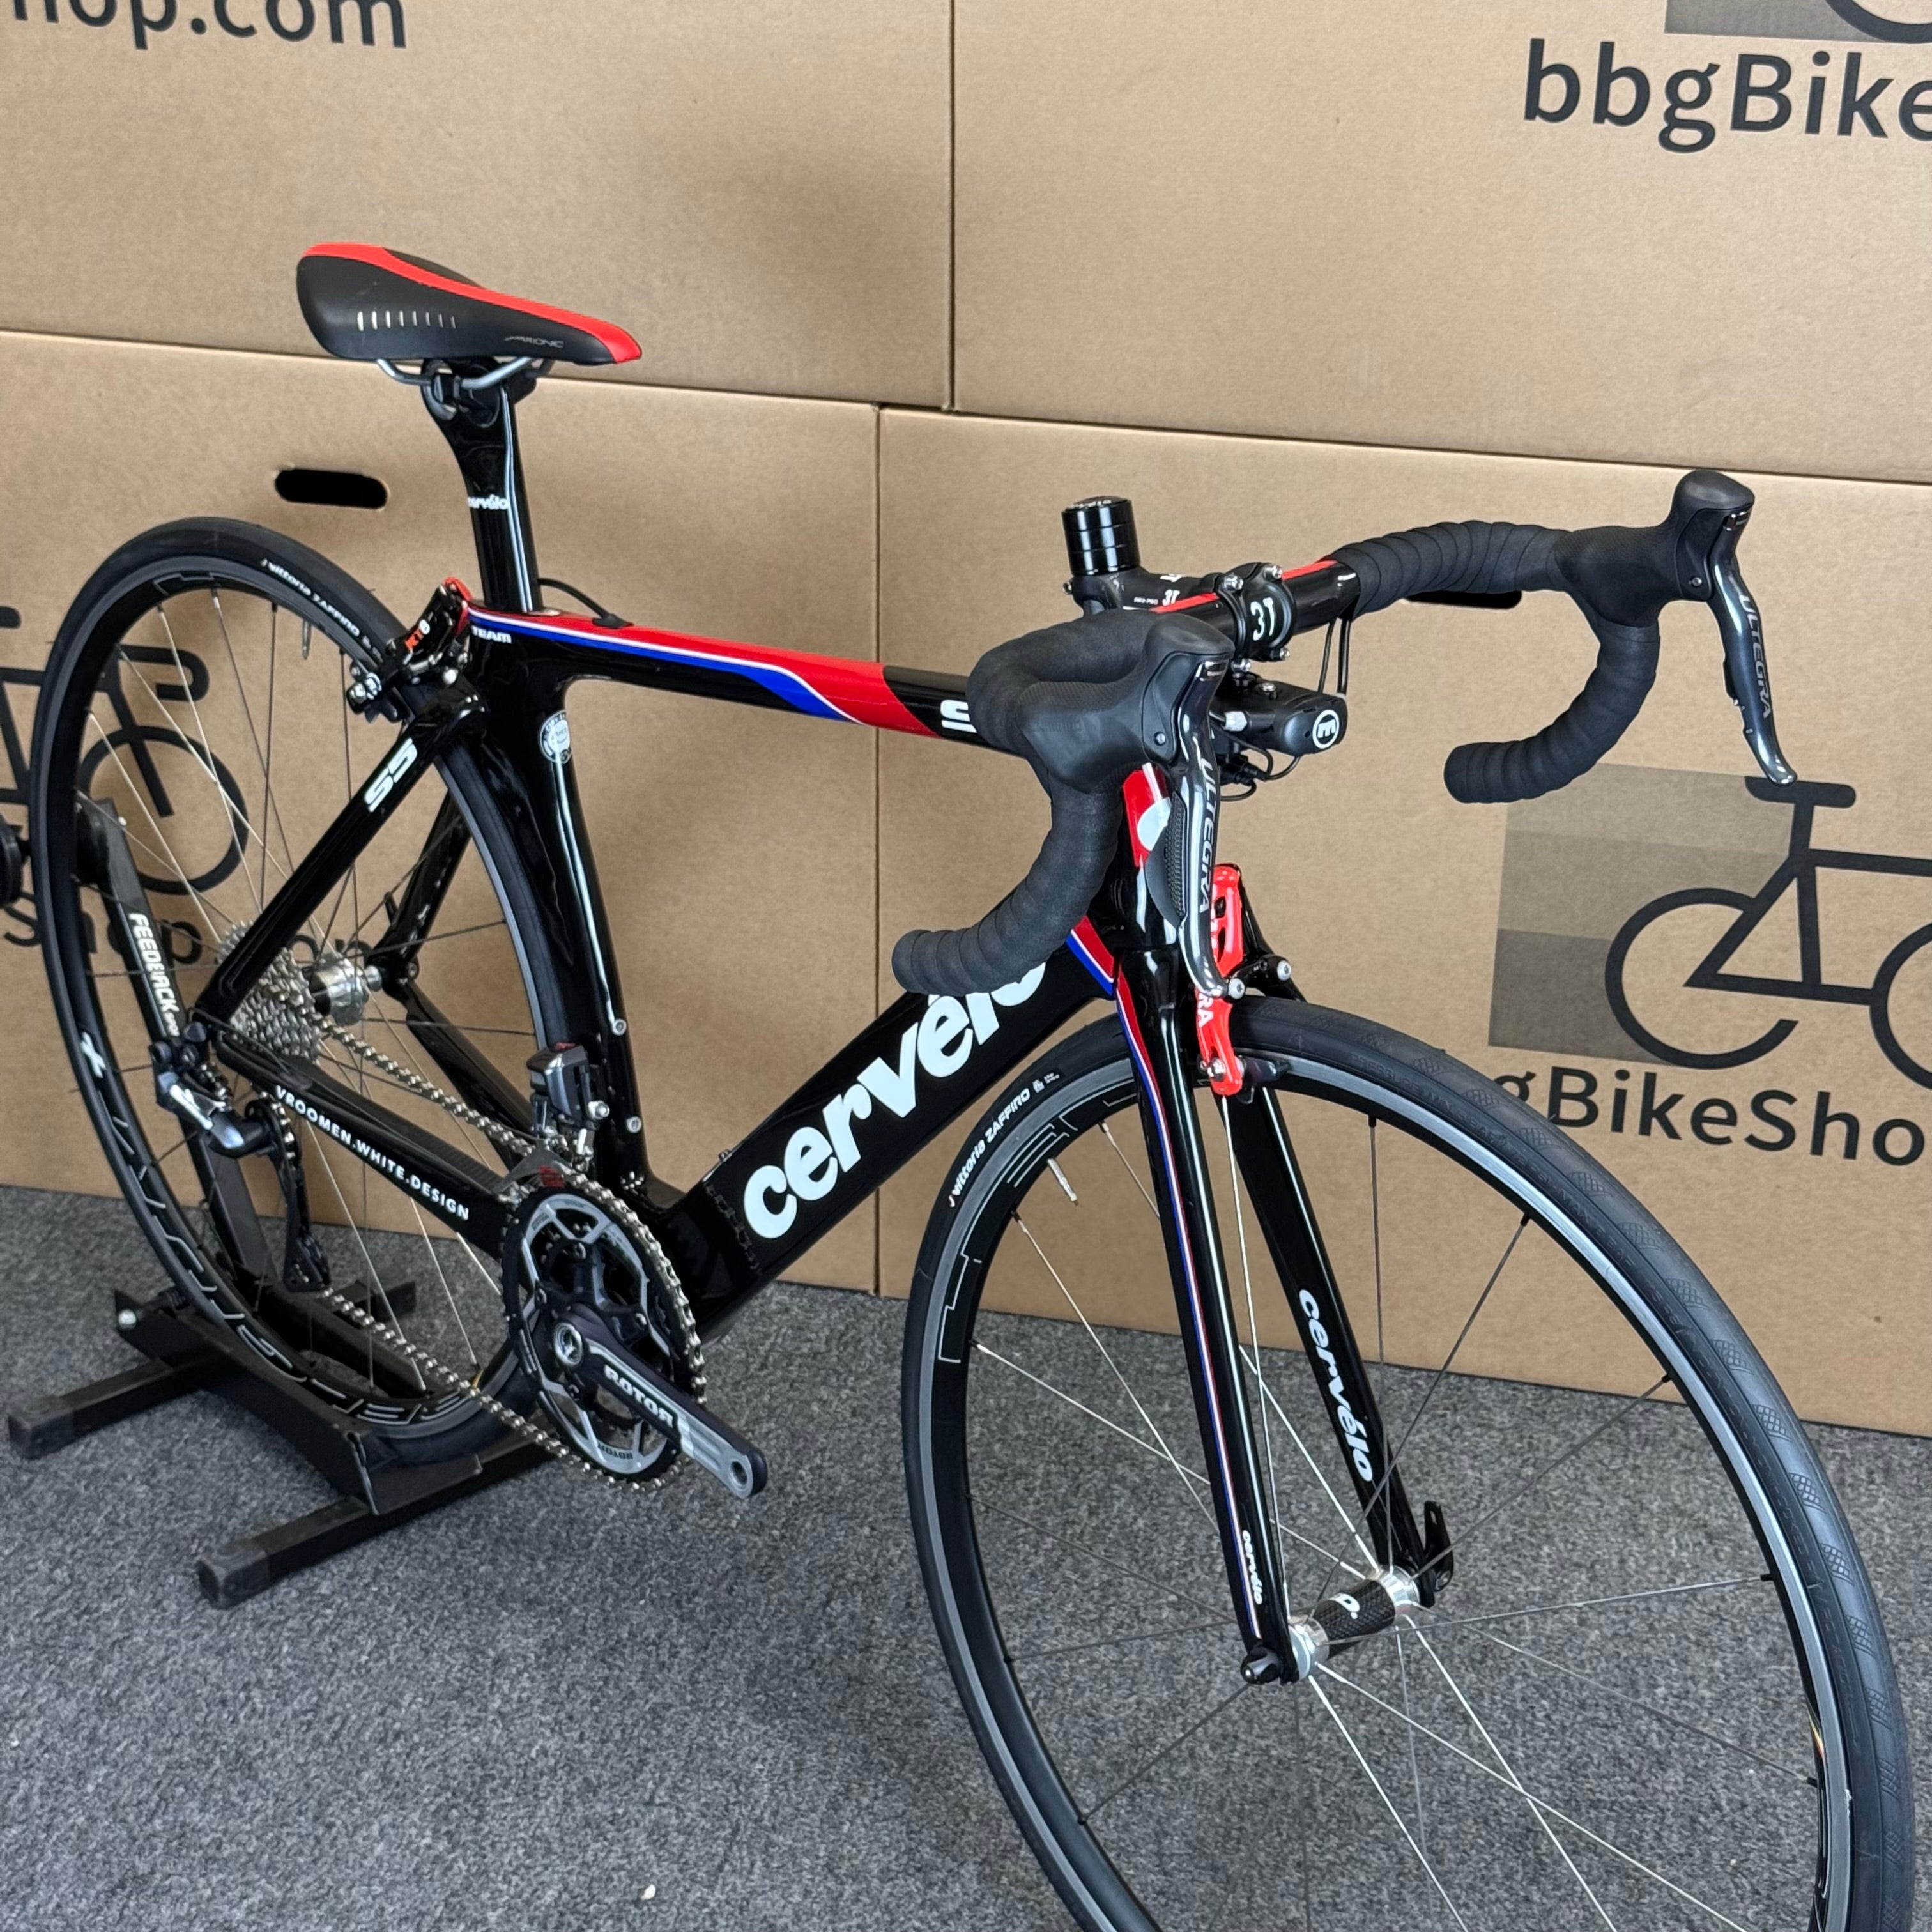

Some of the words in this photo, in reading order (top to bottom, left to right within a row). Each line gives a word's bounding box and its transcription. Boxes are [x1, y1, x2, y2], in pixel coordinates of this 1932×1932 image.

[1524, 38, 1932, 153] bbgBike
[471, 624, 512, 645] TEAM
[1250, 597, 1276, 641] 3T
[1739, 594, 1772, 719] ULTEGRA
[1199, 758, 1217, 914] ULTEGRA
[128, 912, 180, 1013] FEEDBACK
[951, 1139, 986, 1196] vittoria
[985, 1087, 1031, 1144] ZAFFIRO
[603, 1363, 673, 1429] ROTOR
[1299, 1289, 1373, 1482] cervélo
